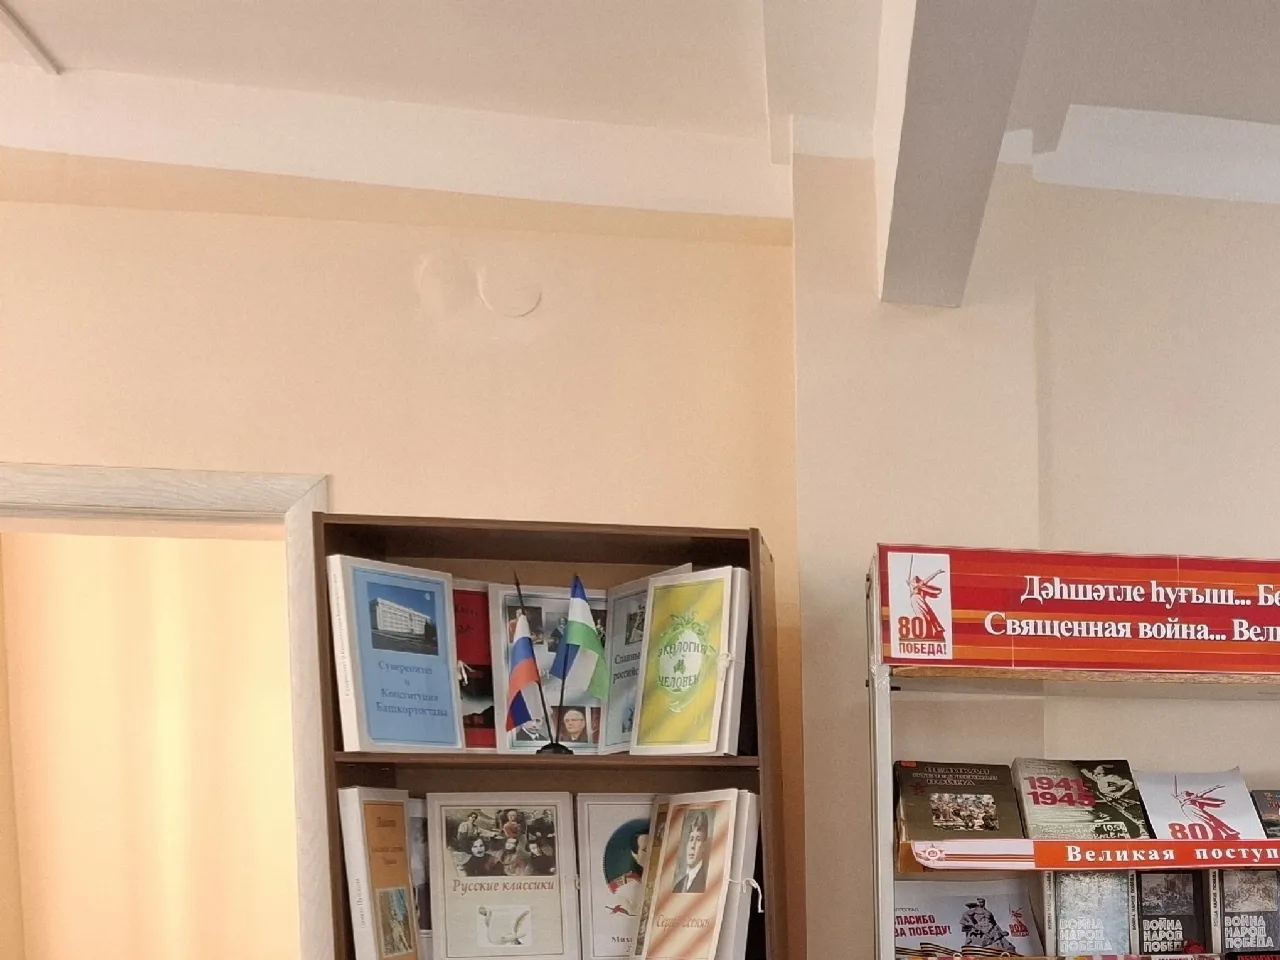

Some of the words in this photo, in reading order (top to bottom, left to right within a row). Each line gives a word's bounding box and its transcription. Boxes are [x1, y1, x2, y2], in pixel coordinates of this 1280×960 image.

[1020, 575, 1146, 605] Дәһшәтле
[1149, 579, 1252, 615] һуғыш...
[898, 616, 924, 640] 80
[984, 611, 1134, 640] Священная
[1138, 620, 1227, 643] война...
[899, 641, 948, 657] ПОБЕДА!
[1027, 791, 1097, 808] 1945
[1066, 843, 1177, 863] Великая
[452, 879, 500, 896] Русские
[502, 880, 555, 892] классики
[1060, 916, 1104, 930] ВОЙНА
[1143, 917, 1183, 930] ВОЙНА
[1224, 914, 1266, 927] ВОЙНА
[909, 926, 952, 938] ПОБЕДУ!
[1060, 930, 1105, 941] НАРОД
[1143, 930, 1184, 941] НАРОД
[1225, 926, 1267, 938] НАРОД
[1060, 940, 1113, 952] ПОБЕДА
[1143, 941, 1186, 952] ПОБЕД
[1225, 937, 1274, 949] ПОБЕДА
